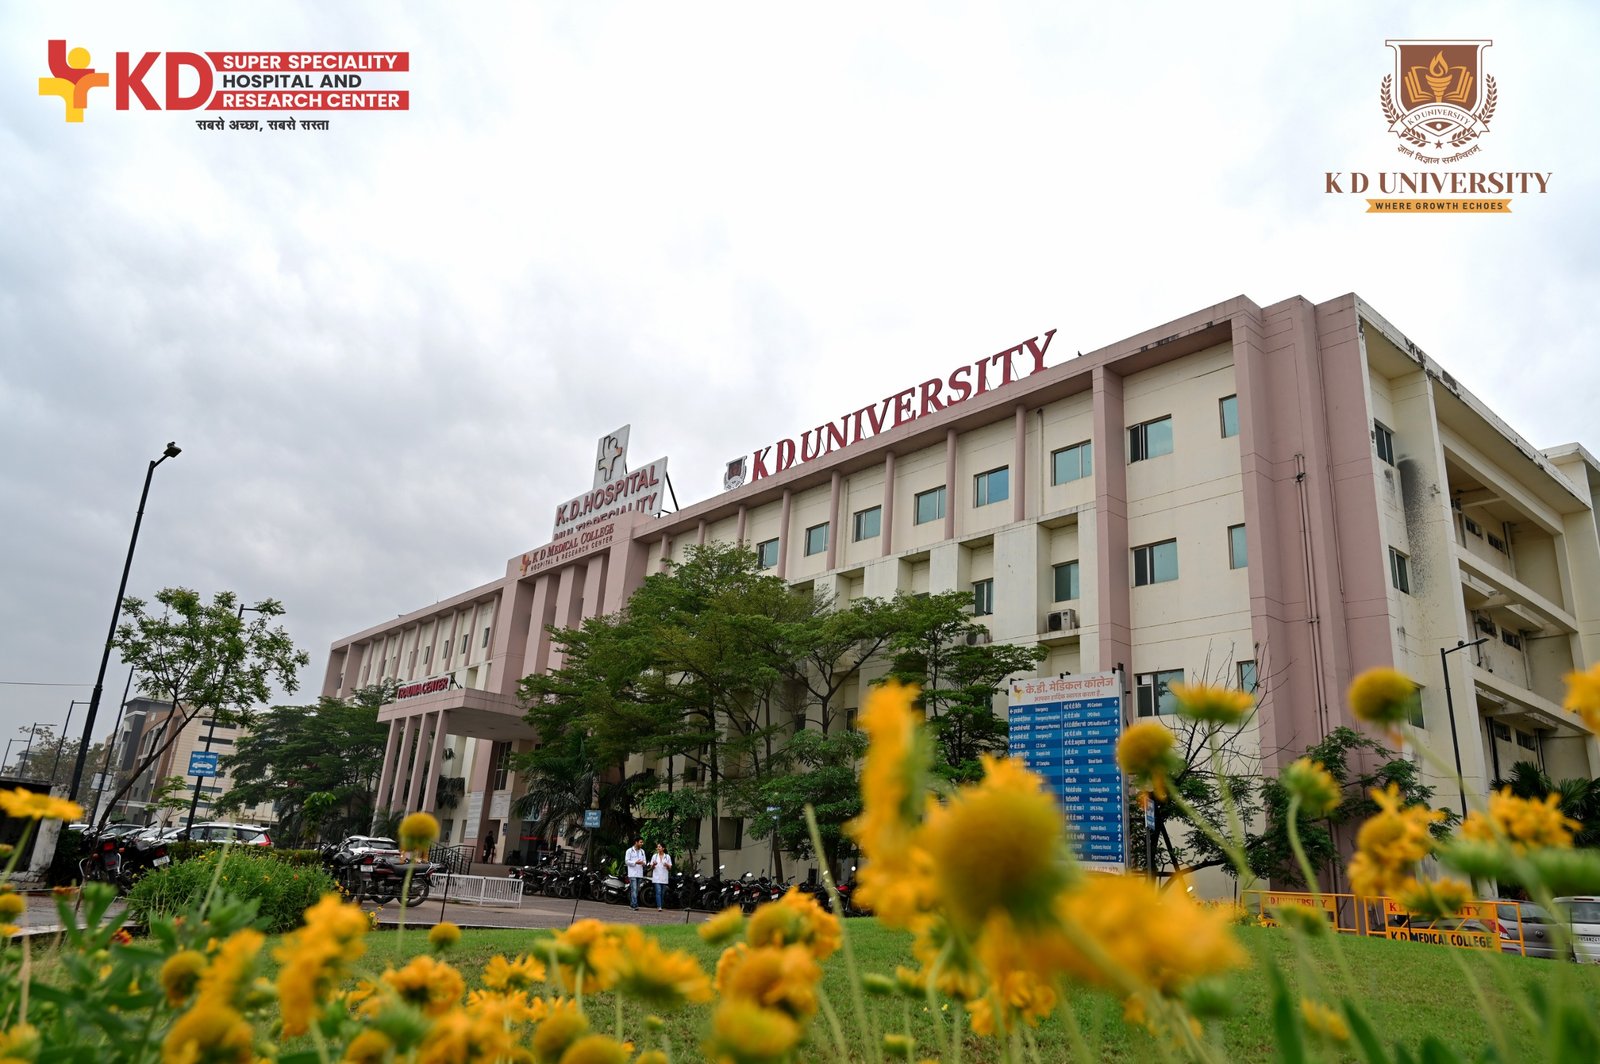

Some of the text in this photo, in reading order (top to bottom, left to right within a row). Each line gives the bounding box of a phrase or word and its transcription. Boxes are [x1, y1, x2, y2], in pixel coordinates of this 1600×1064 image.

[800, 328, 1058, 461] UNIVERSITY
[422, 677, 449, 695] CENTER
[1049, 679, 1082, 693] मेडिकल
[1084, 676, 1114, 689] कॉलेज
[1450, 934, 1493, 949] COLLEGE
